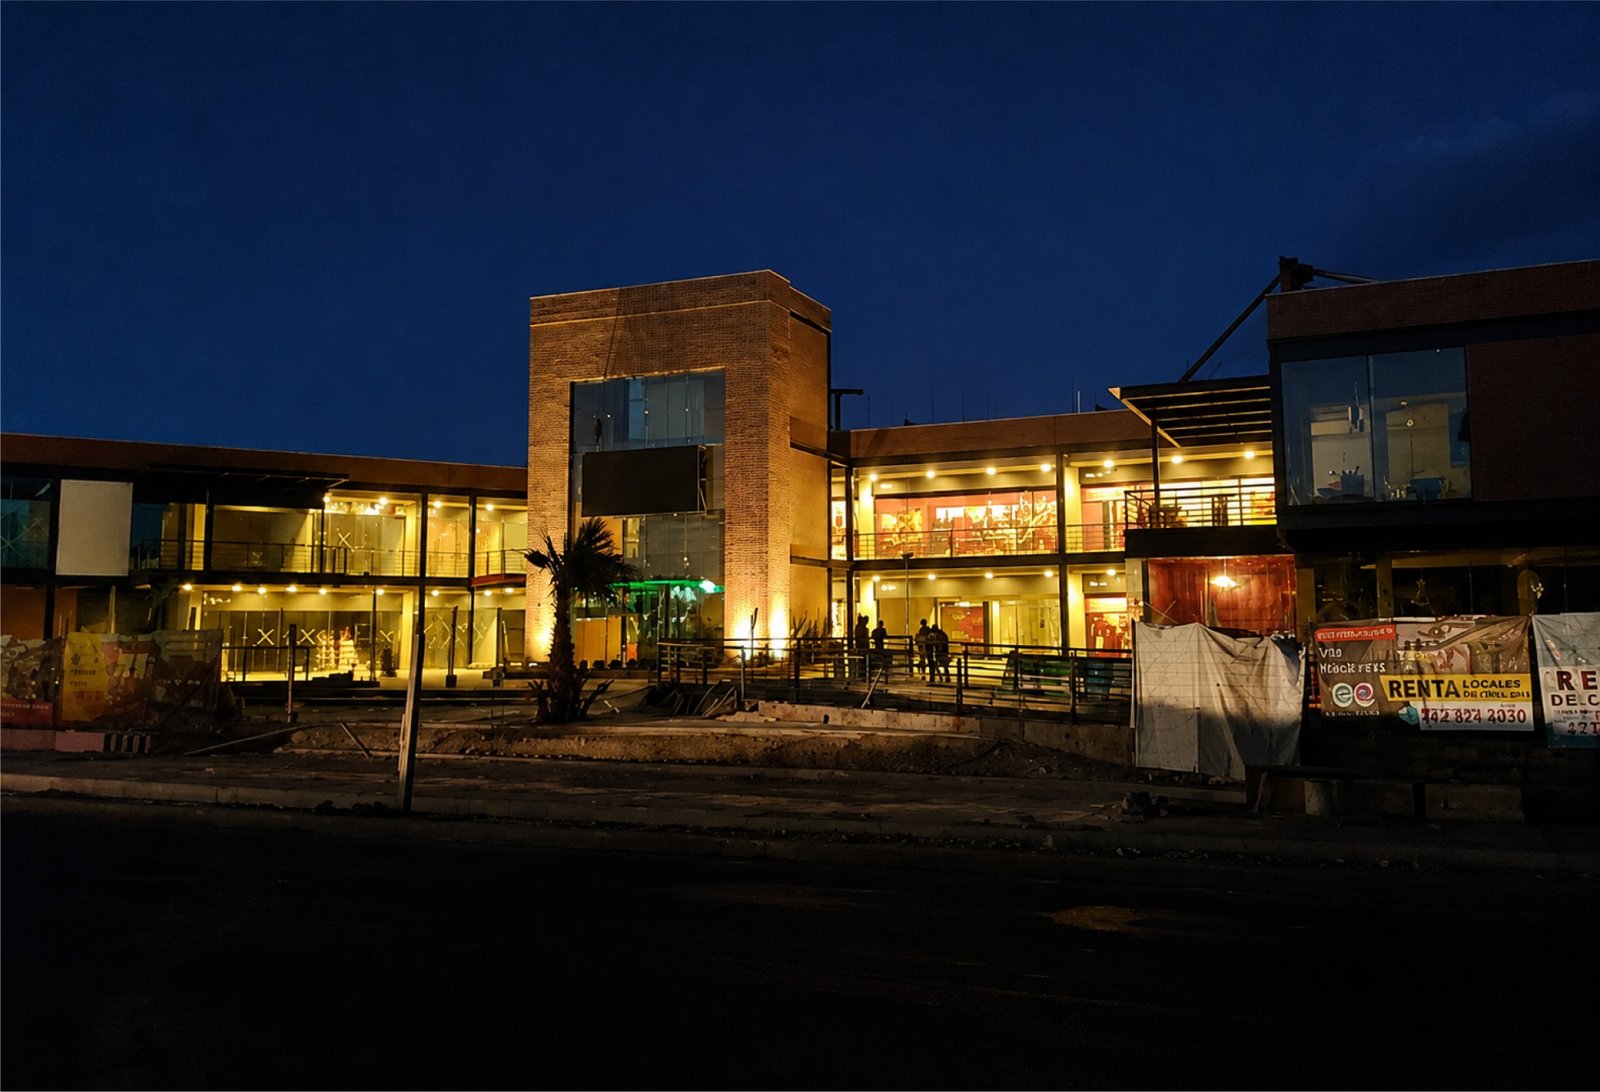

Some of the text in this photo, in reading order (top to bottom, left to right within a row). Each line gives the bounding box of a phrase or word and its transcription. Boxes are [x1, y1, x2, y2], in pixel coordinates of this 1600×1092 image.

[1462, 679, 1521, 689] LOCALES
[1556, 670, 1599, 691] RE
[1388, 679, 1461, 698] RENTA
[1551, 694, 1578, 706] DE
[1455, 708, 1482, 723] 824
